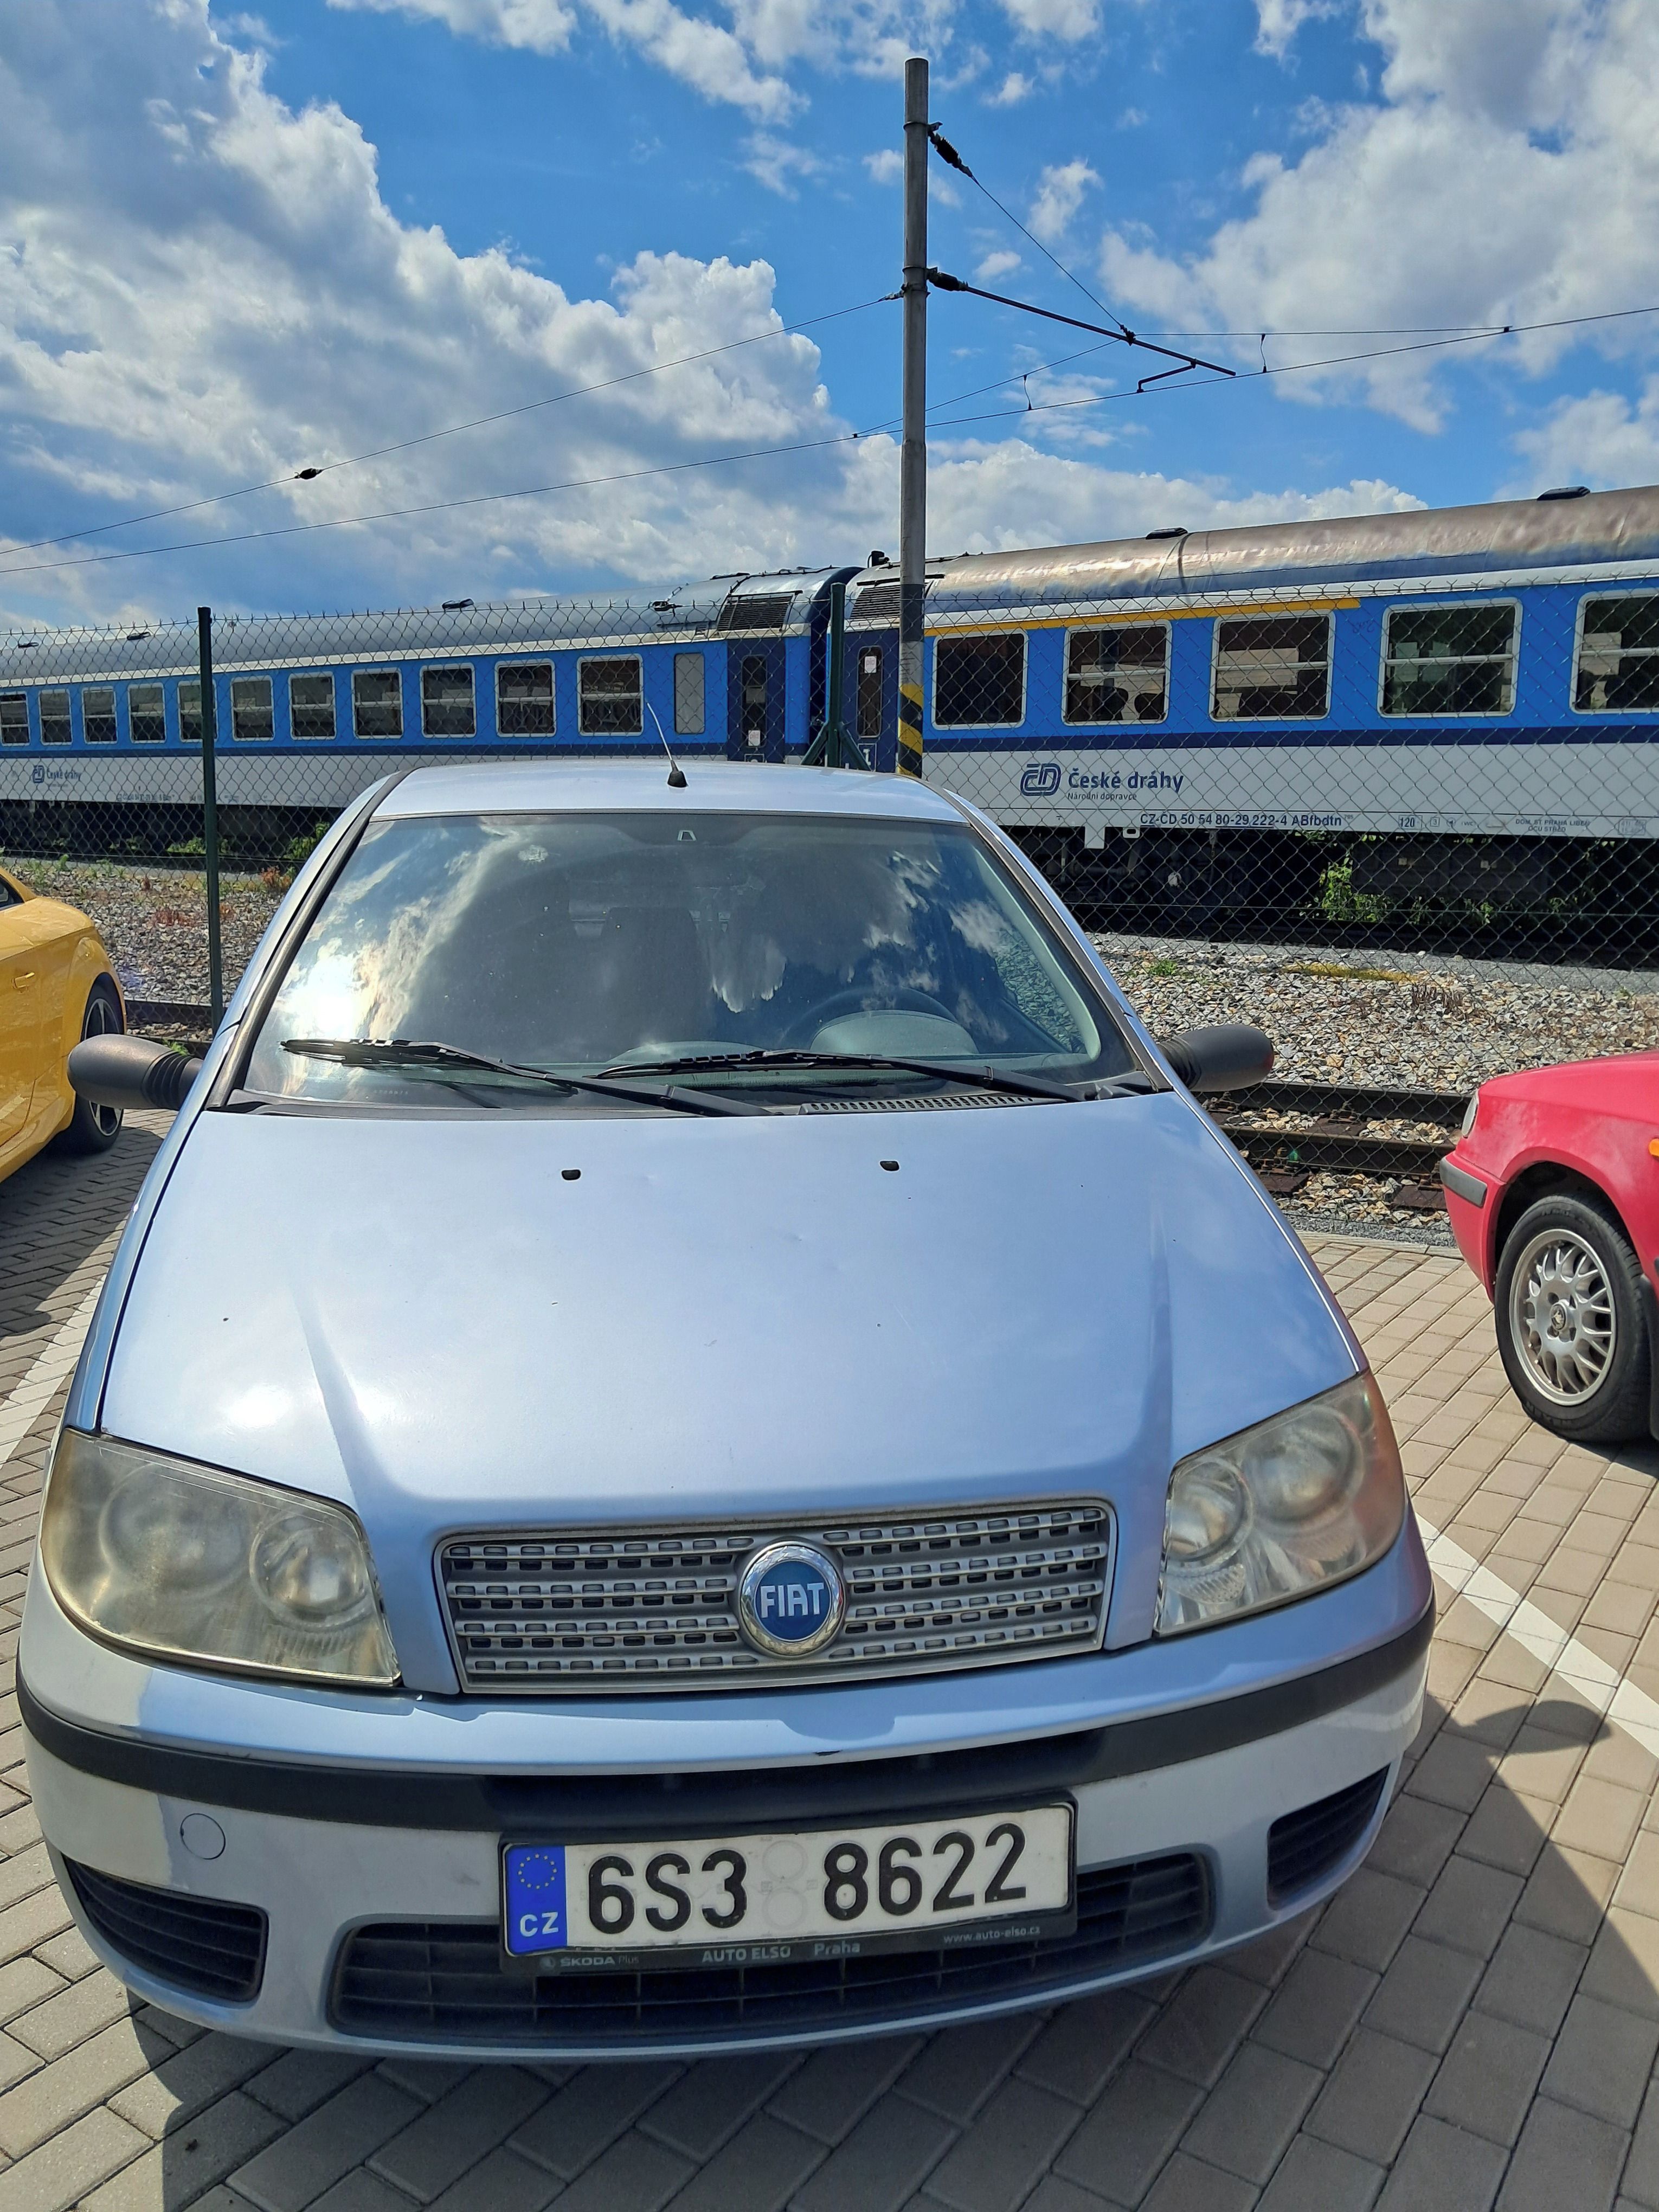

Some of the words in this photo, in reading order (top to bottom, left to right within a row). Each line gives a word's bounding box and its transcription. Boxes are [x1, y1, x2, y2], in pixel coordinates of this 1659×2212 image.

[1068, 768, 1122, 788] České
[1127, 770, 1184, 794] dráhy
[1100, 792, 1137, 801] dopravce
[1181, 814, 1194, 825] 50
[1198, 814, 1212, 825] 54
[1291, 815, 1341, 826] ABfbdtn
[1399, 817, 1414, 827] 120
[760, 1582, 824, 1618] FIAT
[588, 1849, 747, 1934] 6S3
[824, 1823, 1026, 1921] 8622
[519, 1911, 559, 1937] CZ
[943, 1926, 1040, 1944] www.auto-elso.cz
[560, 1956, 615, 1967] ŠKODA
[618, 1955, 639, 1965] Plus
[702, 1949, 747, 1963] AUTO
[751, 1946, 792, 1960] ELSO
[813, 1941, 861, 1956] Praha
